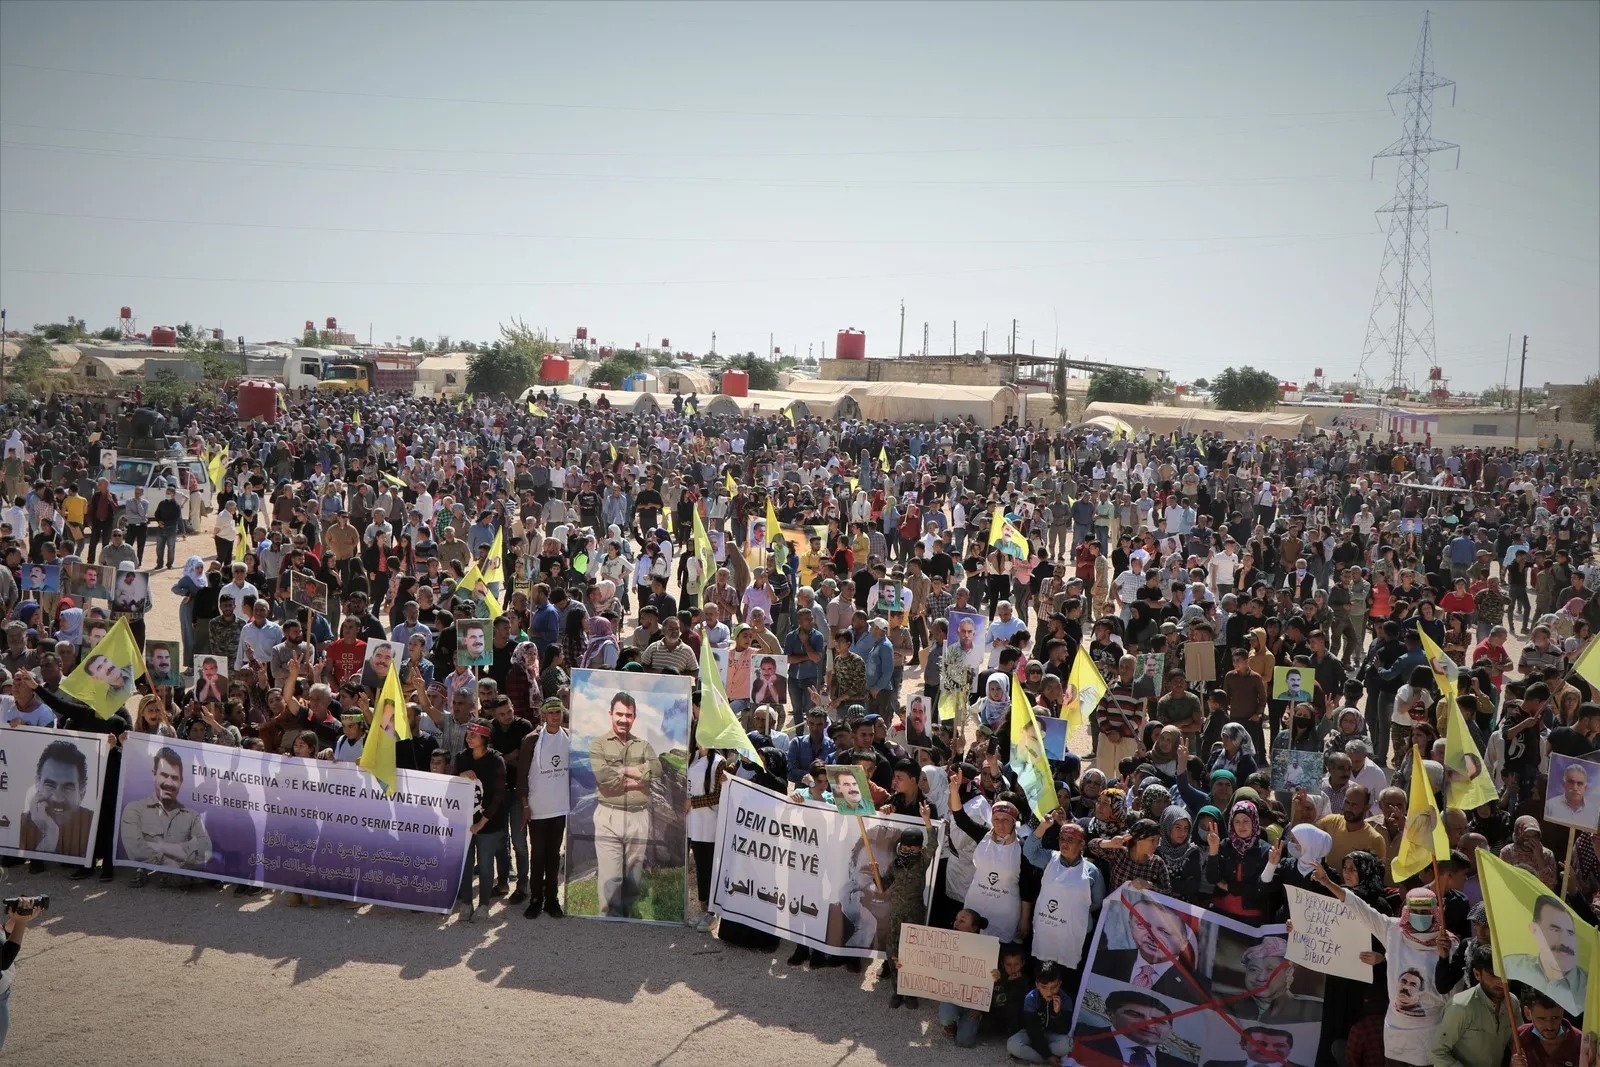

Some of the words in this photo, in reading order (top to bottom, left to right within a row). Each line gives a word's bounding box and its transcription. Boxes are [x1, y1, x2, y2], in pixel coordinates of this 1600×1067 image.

[192, 765, 207, 776] EM
[210, 768, 278, 788] PLANGERIYA
[302, 780, 356, 797] KEWÇERE
[359, 787, 367, 799] A
[446, 798, 460, 810] YA
[192, 792, 200, 802] LI
[202, 794, 220, 806] SER
[223, 797, 260, 811] REBERE
[263, 803, 297, 817] GELAN
[300, 808, 333, 822] SEROK
[336, 813, 358, 826] APO
[361, 817, 419, 833] SERMEZAR
[422, 824, 454, 837] DIKIN
[736, 807, 766, 833] DEM
[769, 819, 819, 846] DEMA
[288, 839, 317, 853] تشرين
[731, 834, 797, 868] AZADIYE
[800, 854, 819, 875] YÊ
[371, 849, 411, 867] ونستنكر
[413, 856, 439, 870] ندين
[318, 867, 360, 880] الشعوب
[385, 873, 408, 890] تجاه
[411, 874, 448, 892] الدولية
[757, 886, 786, 911] وقت
[789, 894, 819, 917] حان
[904, 947, 987, 979] KOMPLOYA
[1303, 949, 1332, 966] BIBIN
